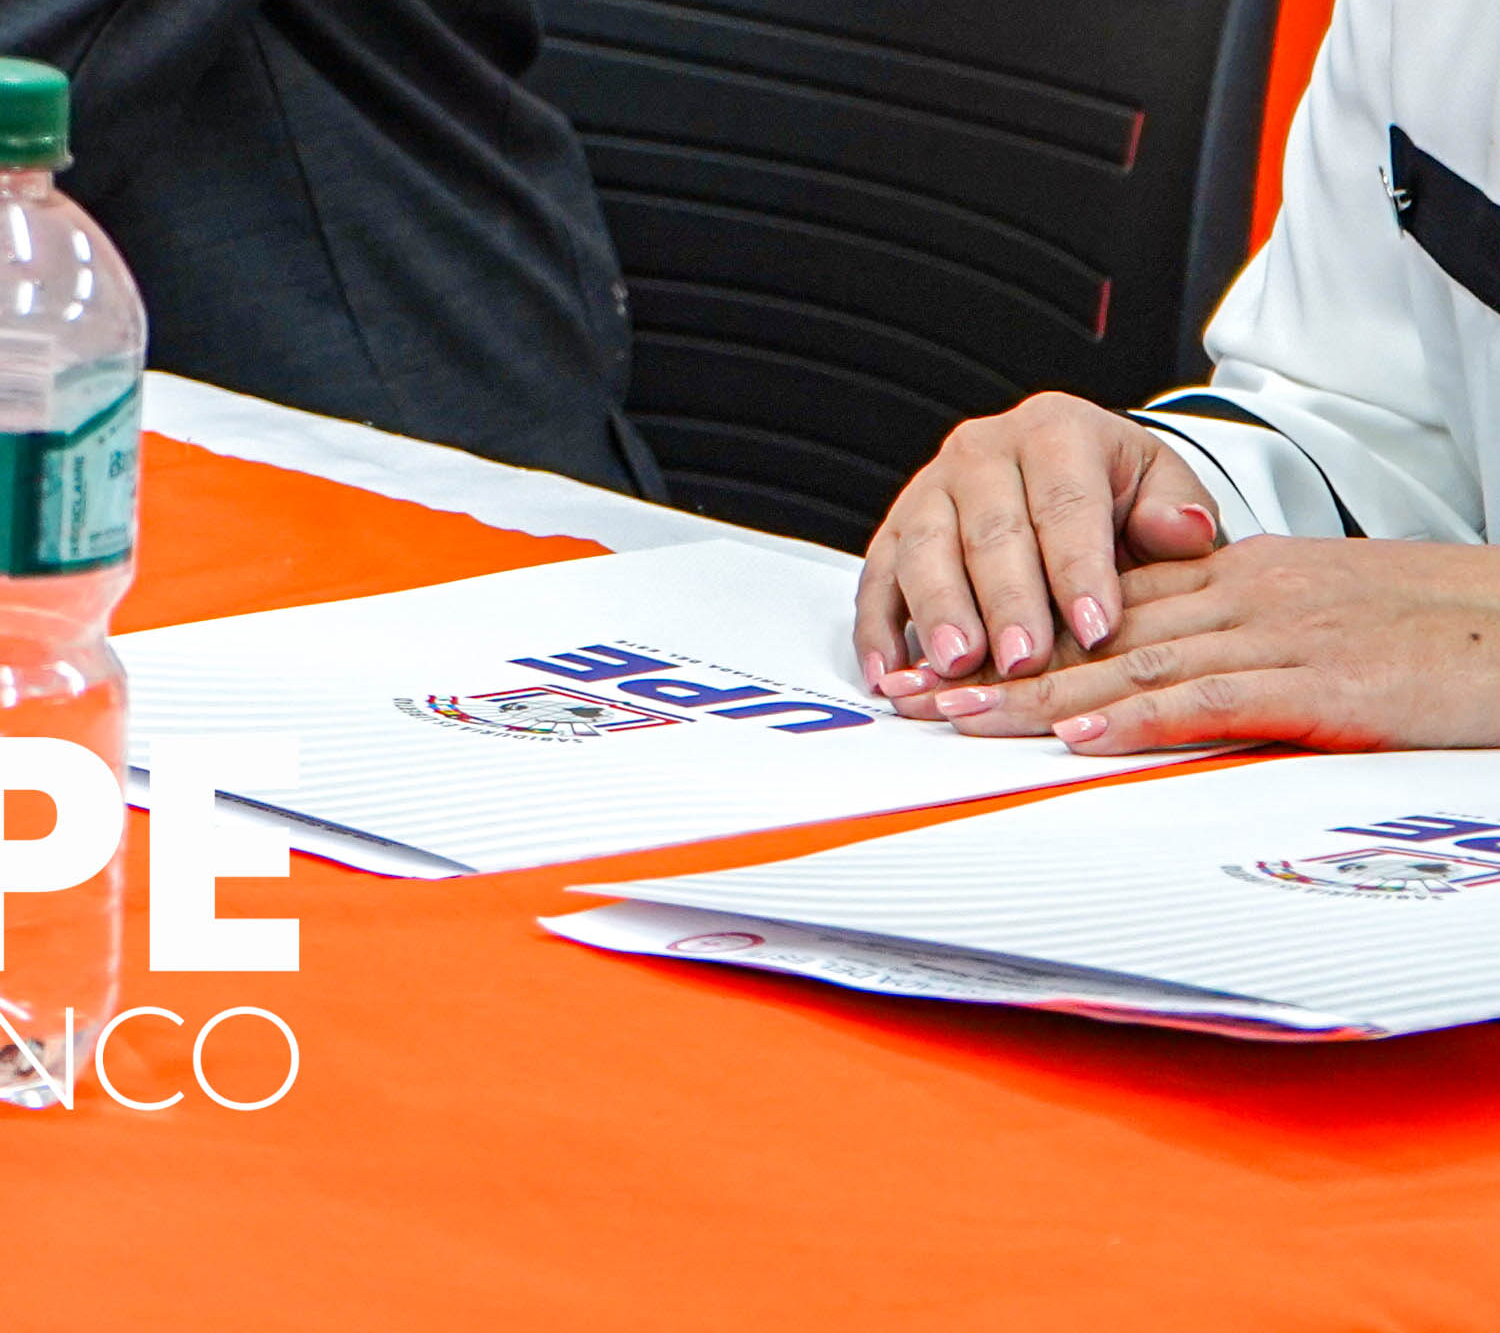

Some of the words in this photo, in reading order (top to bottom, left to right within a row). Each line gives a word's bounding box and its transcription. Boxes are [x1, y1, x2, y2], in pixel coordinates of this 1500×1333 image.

[613, 639, 661, 653] ESTE
[669, 653, 702, 665] DEL
[708, 664, 785, 688] PRIVADA
[506, 644, 874, 734] UPE
